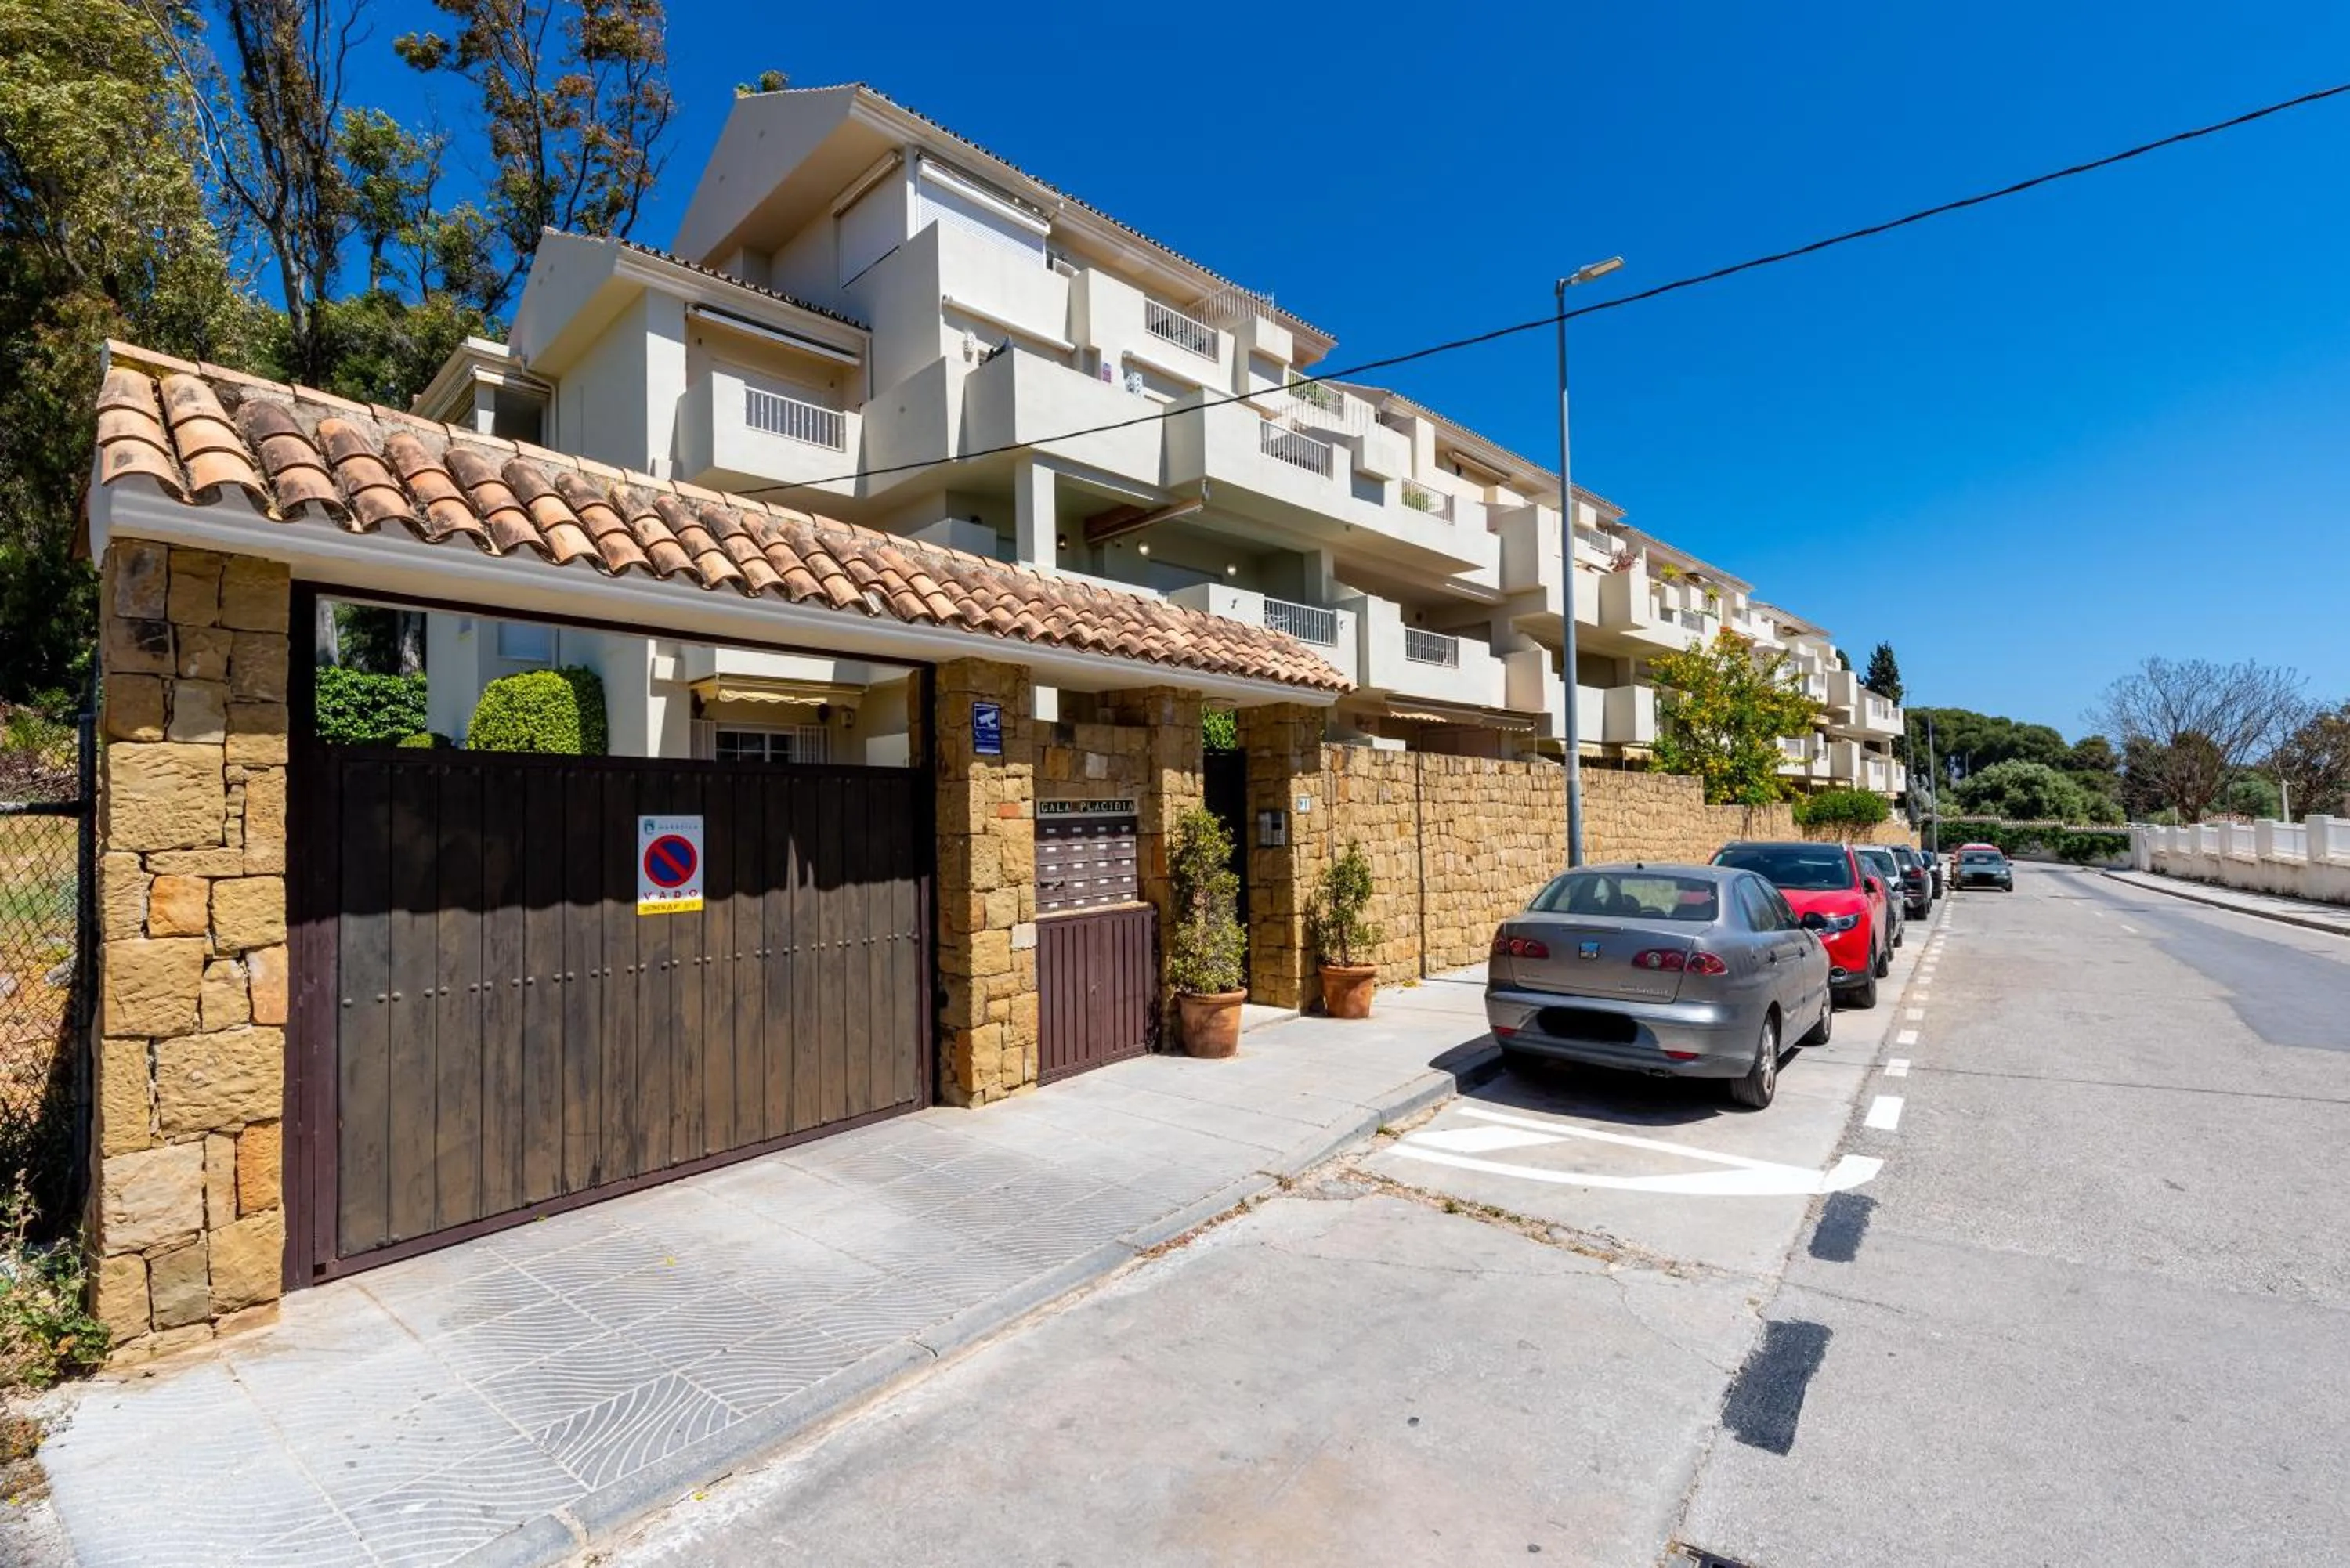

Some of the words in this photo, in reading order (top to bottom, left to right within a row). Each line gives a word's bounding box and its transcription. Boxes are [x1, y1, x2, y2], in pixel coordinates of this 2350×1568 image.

[1040, 802, 1070, 813] GALA
[1079, 800, 1134, 813] PLACIDIA
[643, 889, 698, 900] VADO
